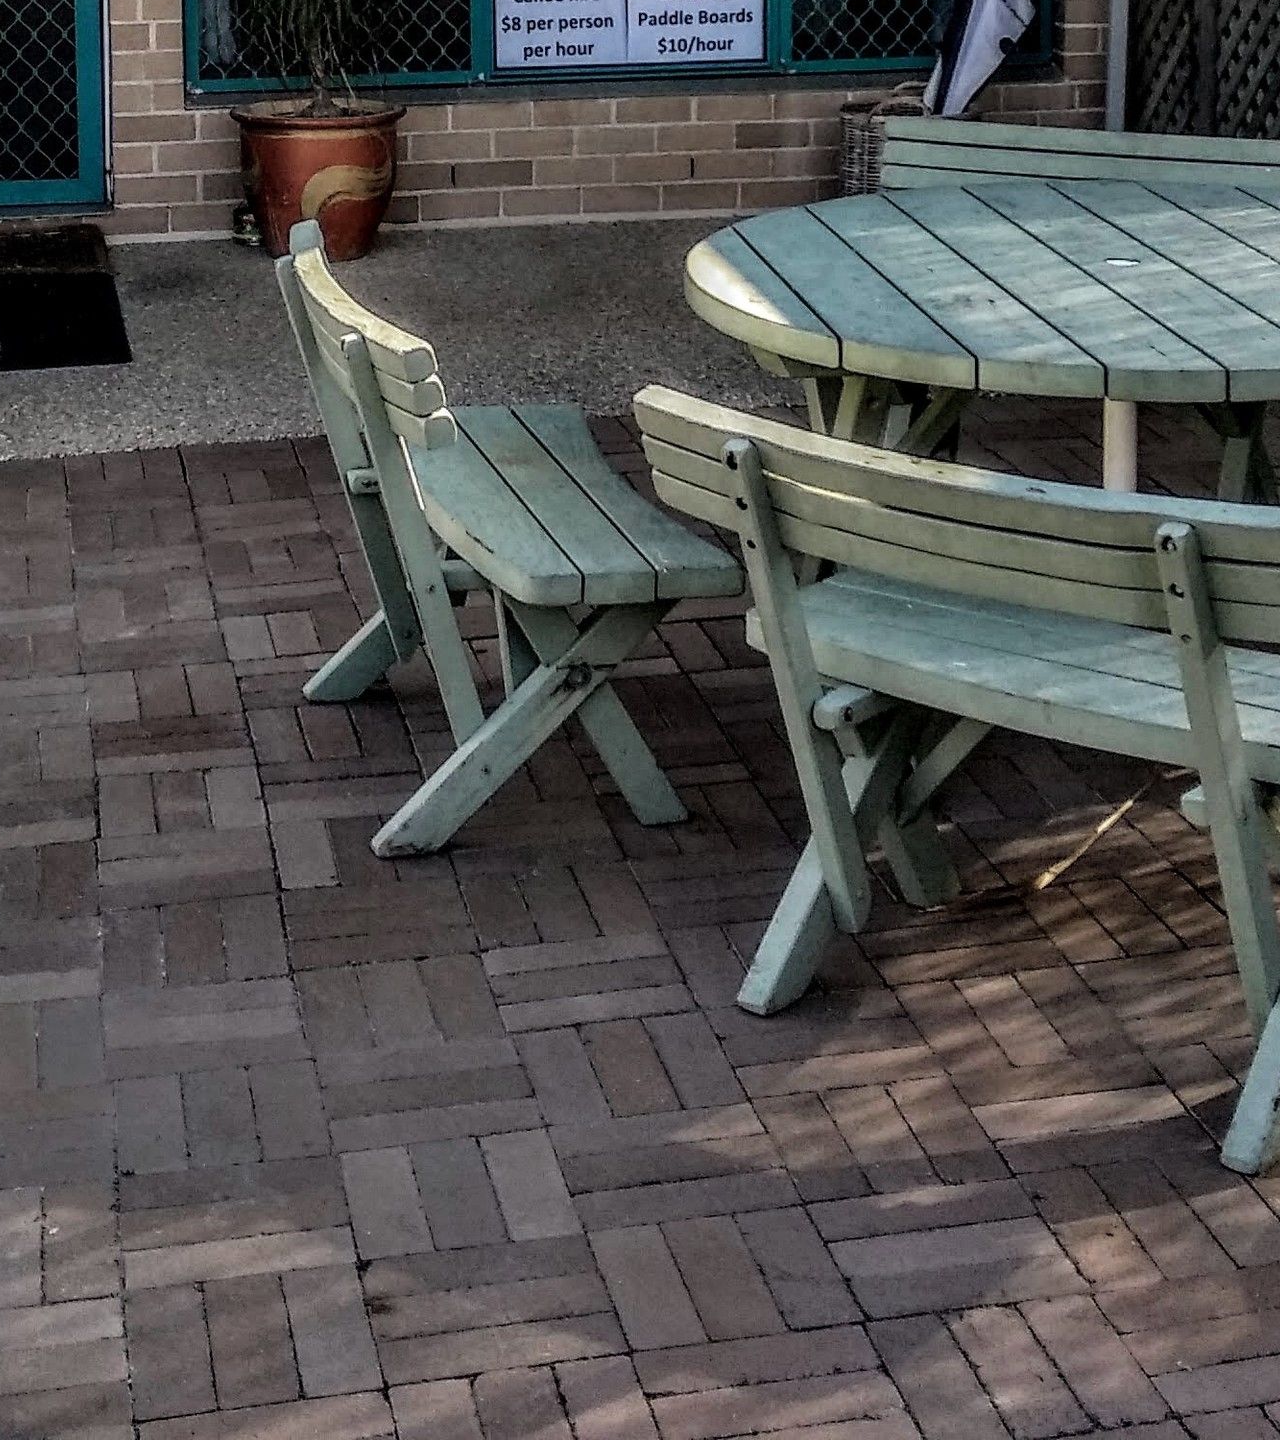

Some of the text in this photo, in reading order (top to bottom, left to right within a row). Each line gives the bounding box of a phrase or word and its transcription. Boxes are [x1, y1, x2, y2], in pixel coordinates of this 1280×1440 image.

[501, 15, 614, 34] $8 per person
[638, 8, 754, 27] Paddle Boards
[523, 41, 595, 61] per hour
[657, 36, 734, 55] $10/hour
